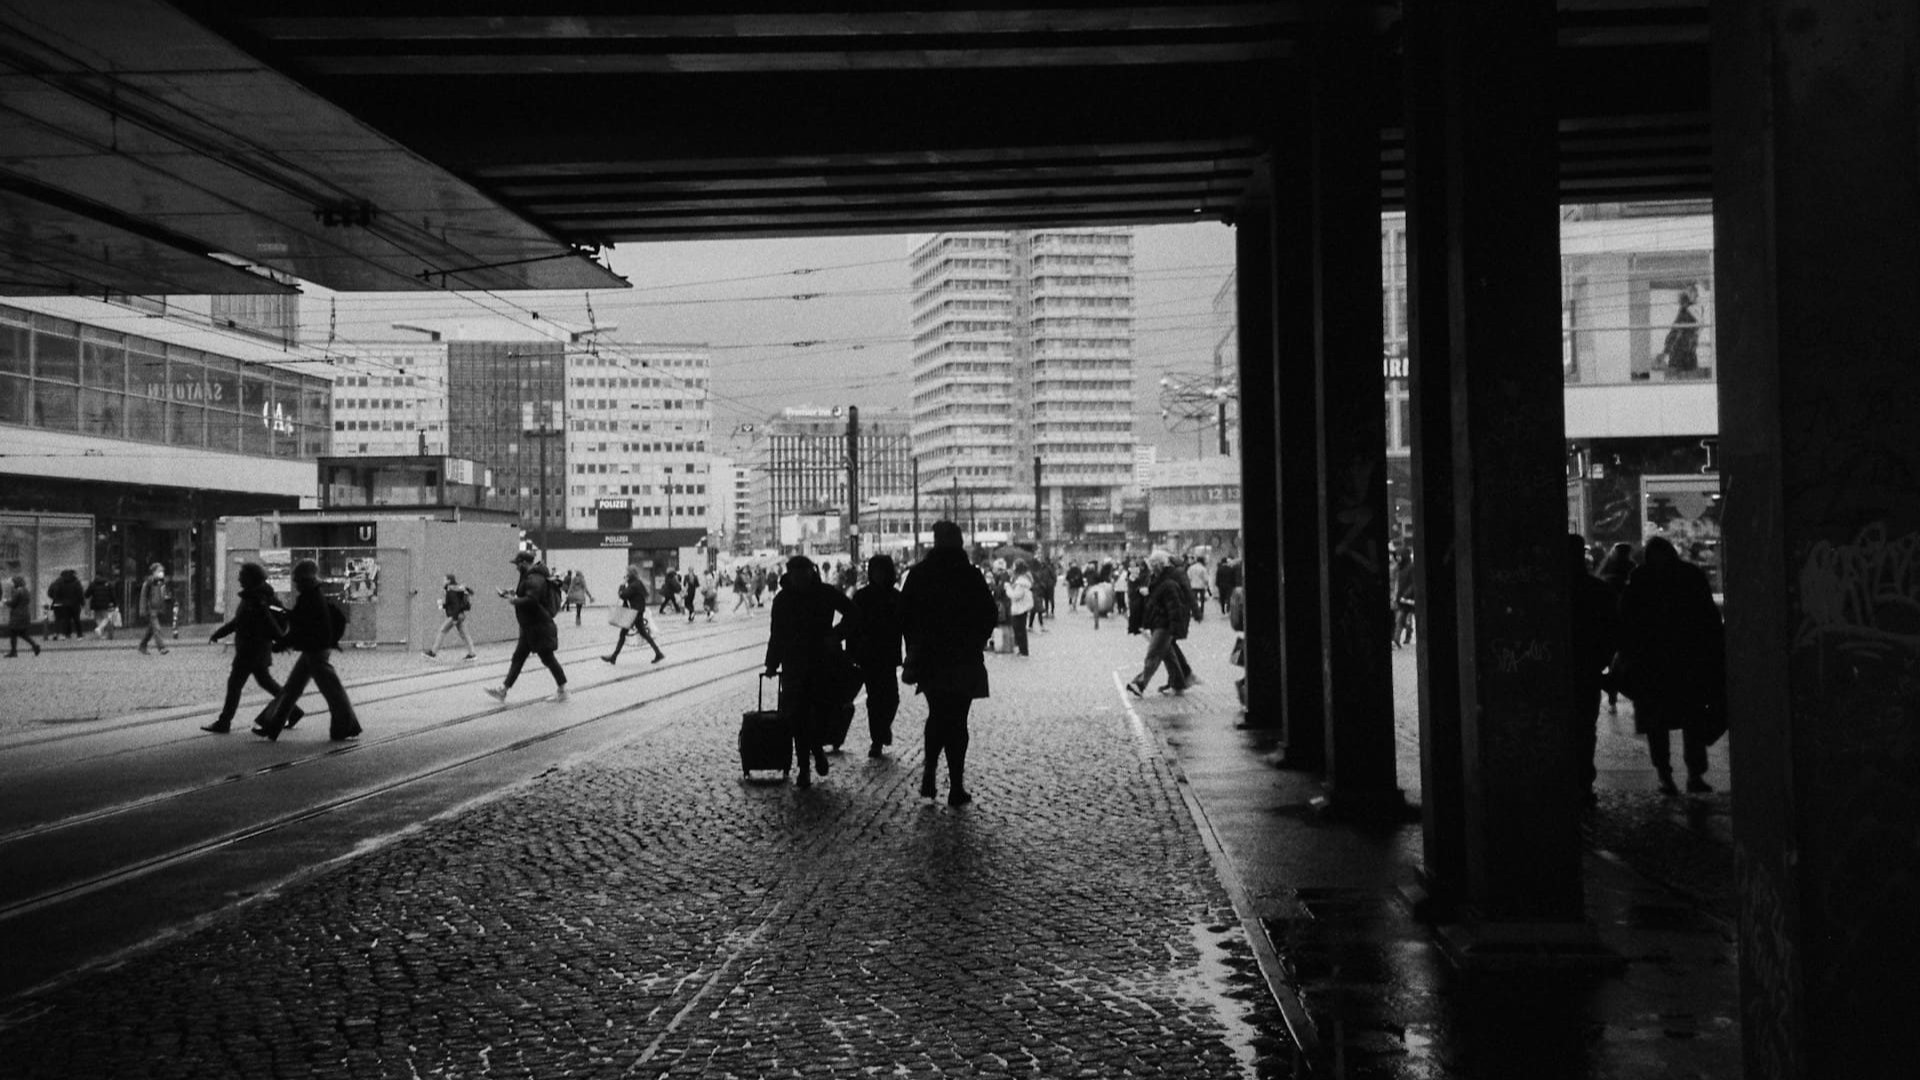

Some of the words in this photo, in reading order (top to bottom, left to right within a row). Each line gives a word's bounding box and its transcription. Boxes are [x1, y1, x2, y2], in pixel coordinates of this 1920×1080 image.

[599, 500, 627, 509] POLIZEI
[359, 525, 372, 542] U
[605, 535, 628, 543] POLIZEI
